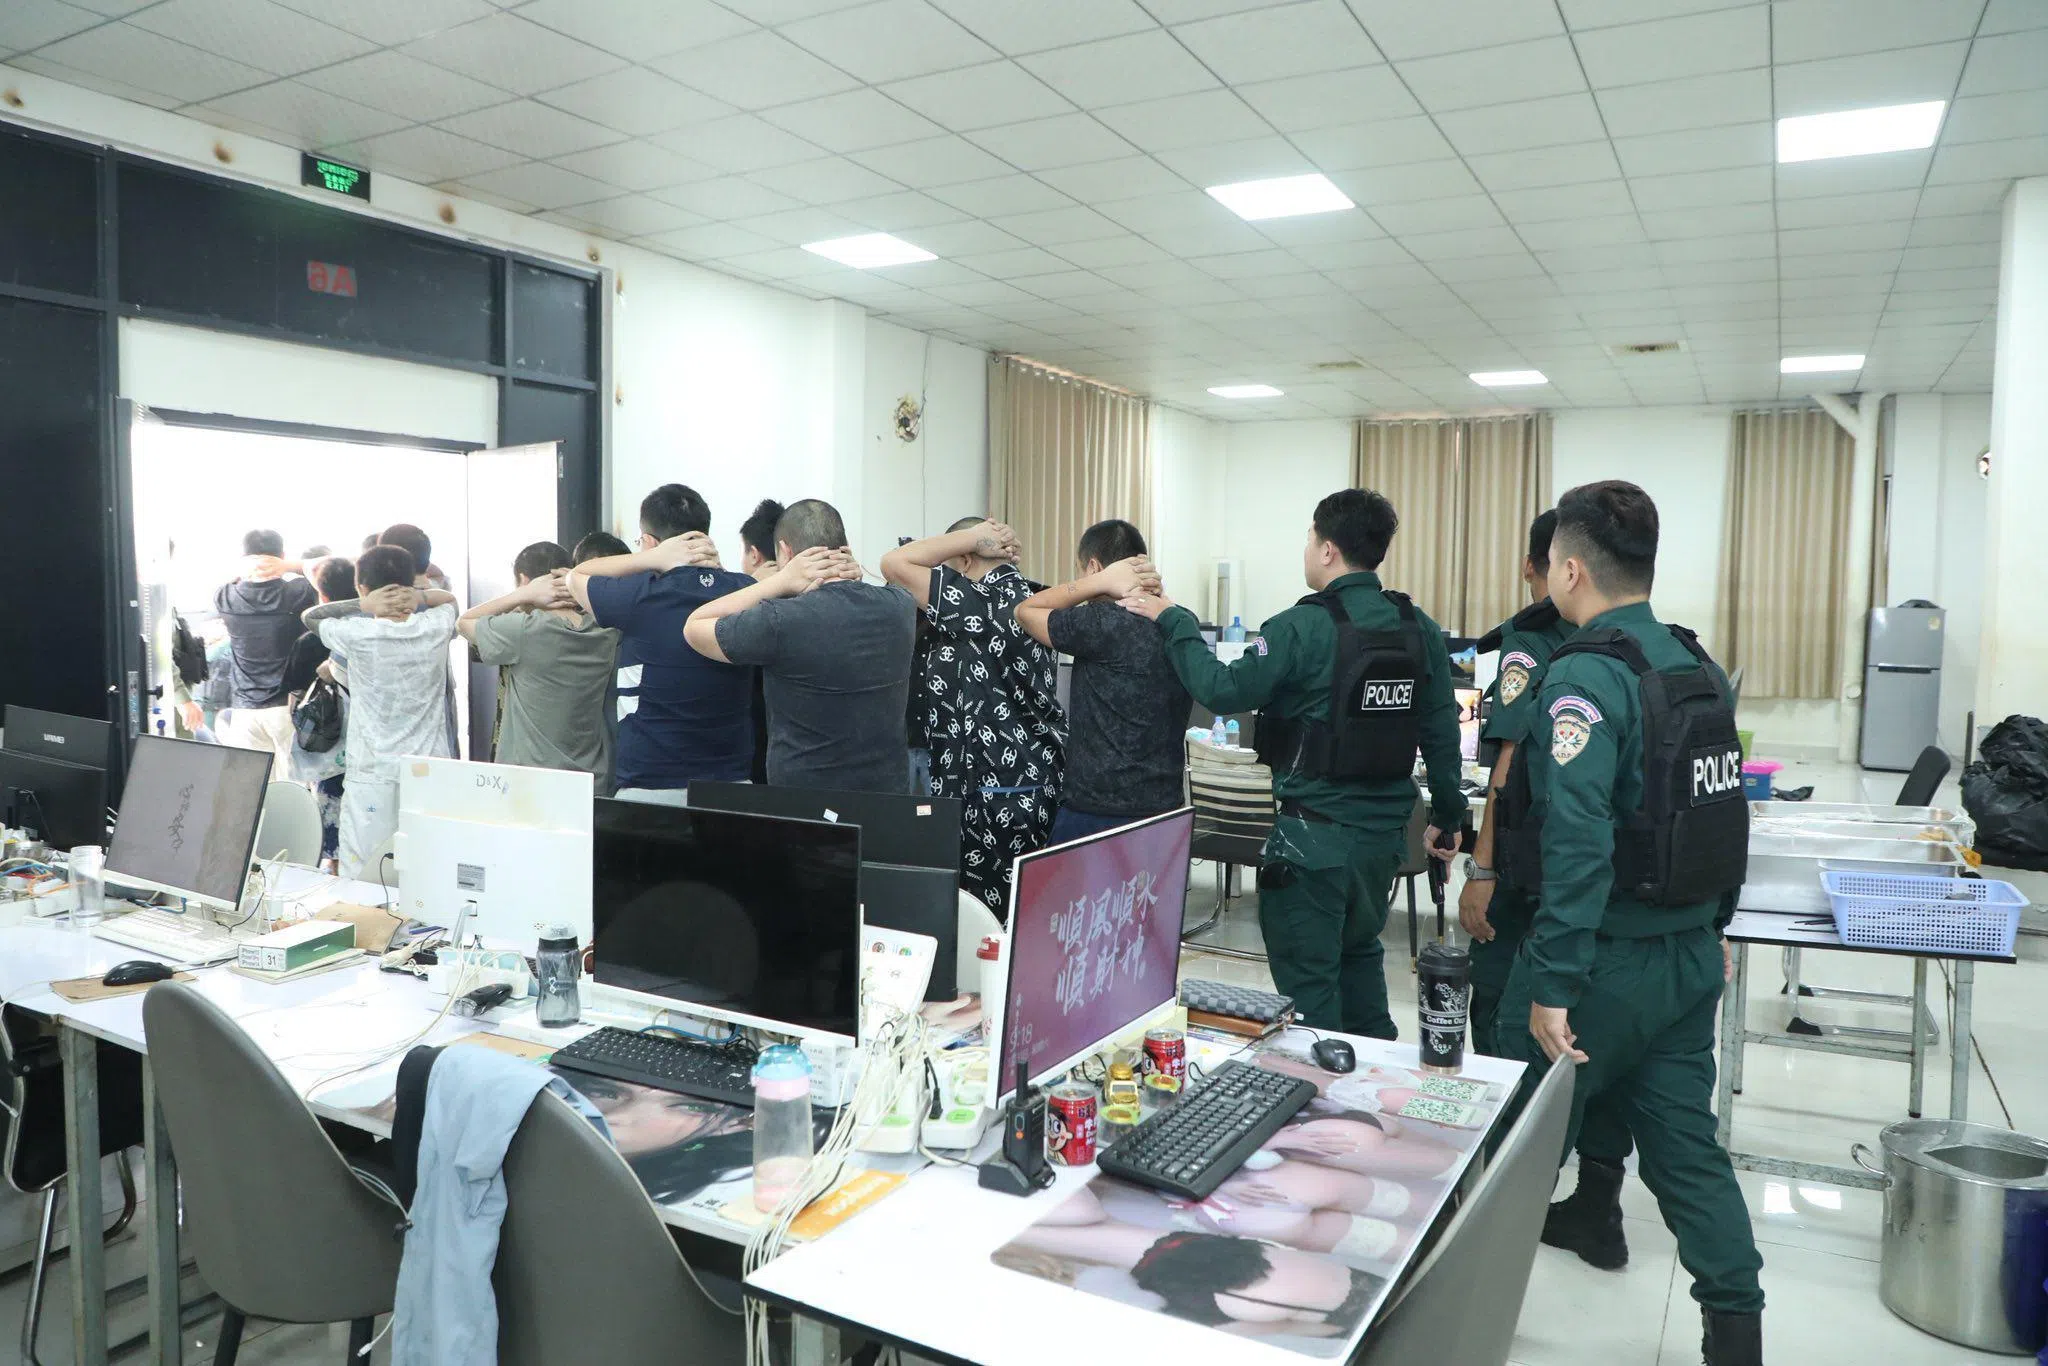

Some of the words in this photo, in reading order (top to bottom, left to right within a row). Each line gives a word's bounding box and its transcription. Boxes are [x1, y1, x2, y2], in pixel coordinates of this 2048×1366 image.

[1365, 684, 1412, 706] POLICE
[1693, 751, 1740, 797] POLICE
[267, 954, 277, 967] 31
[1426, 1015, 1453, 1025] Coffee
